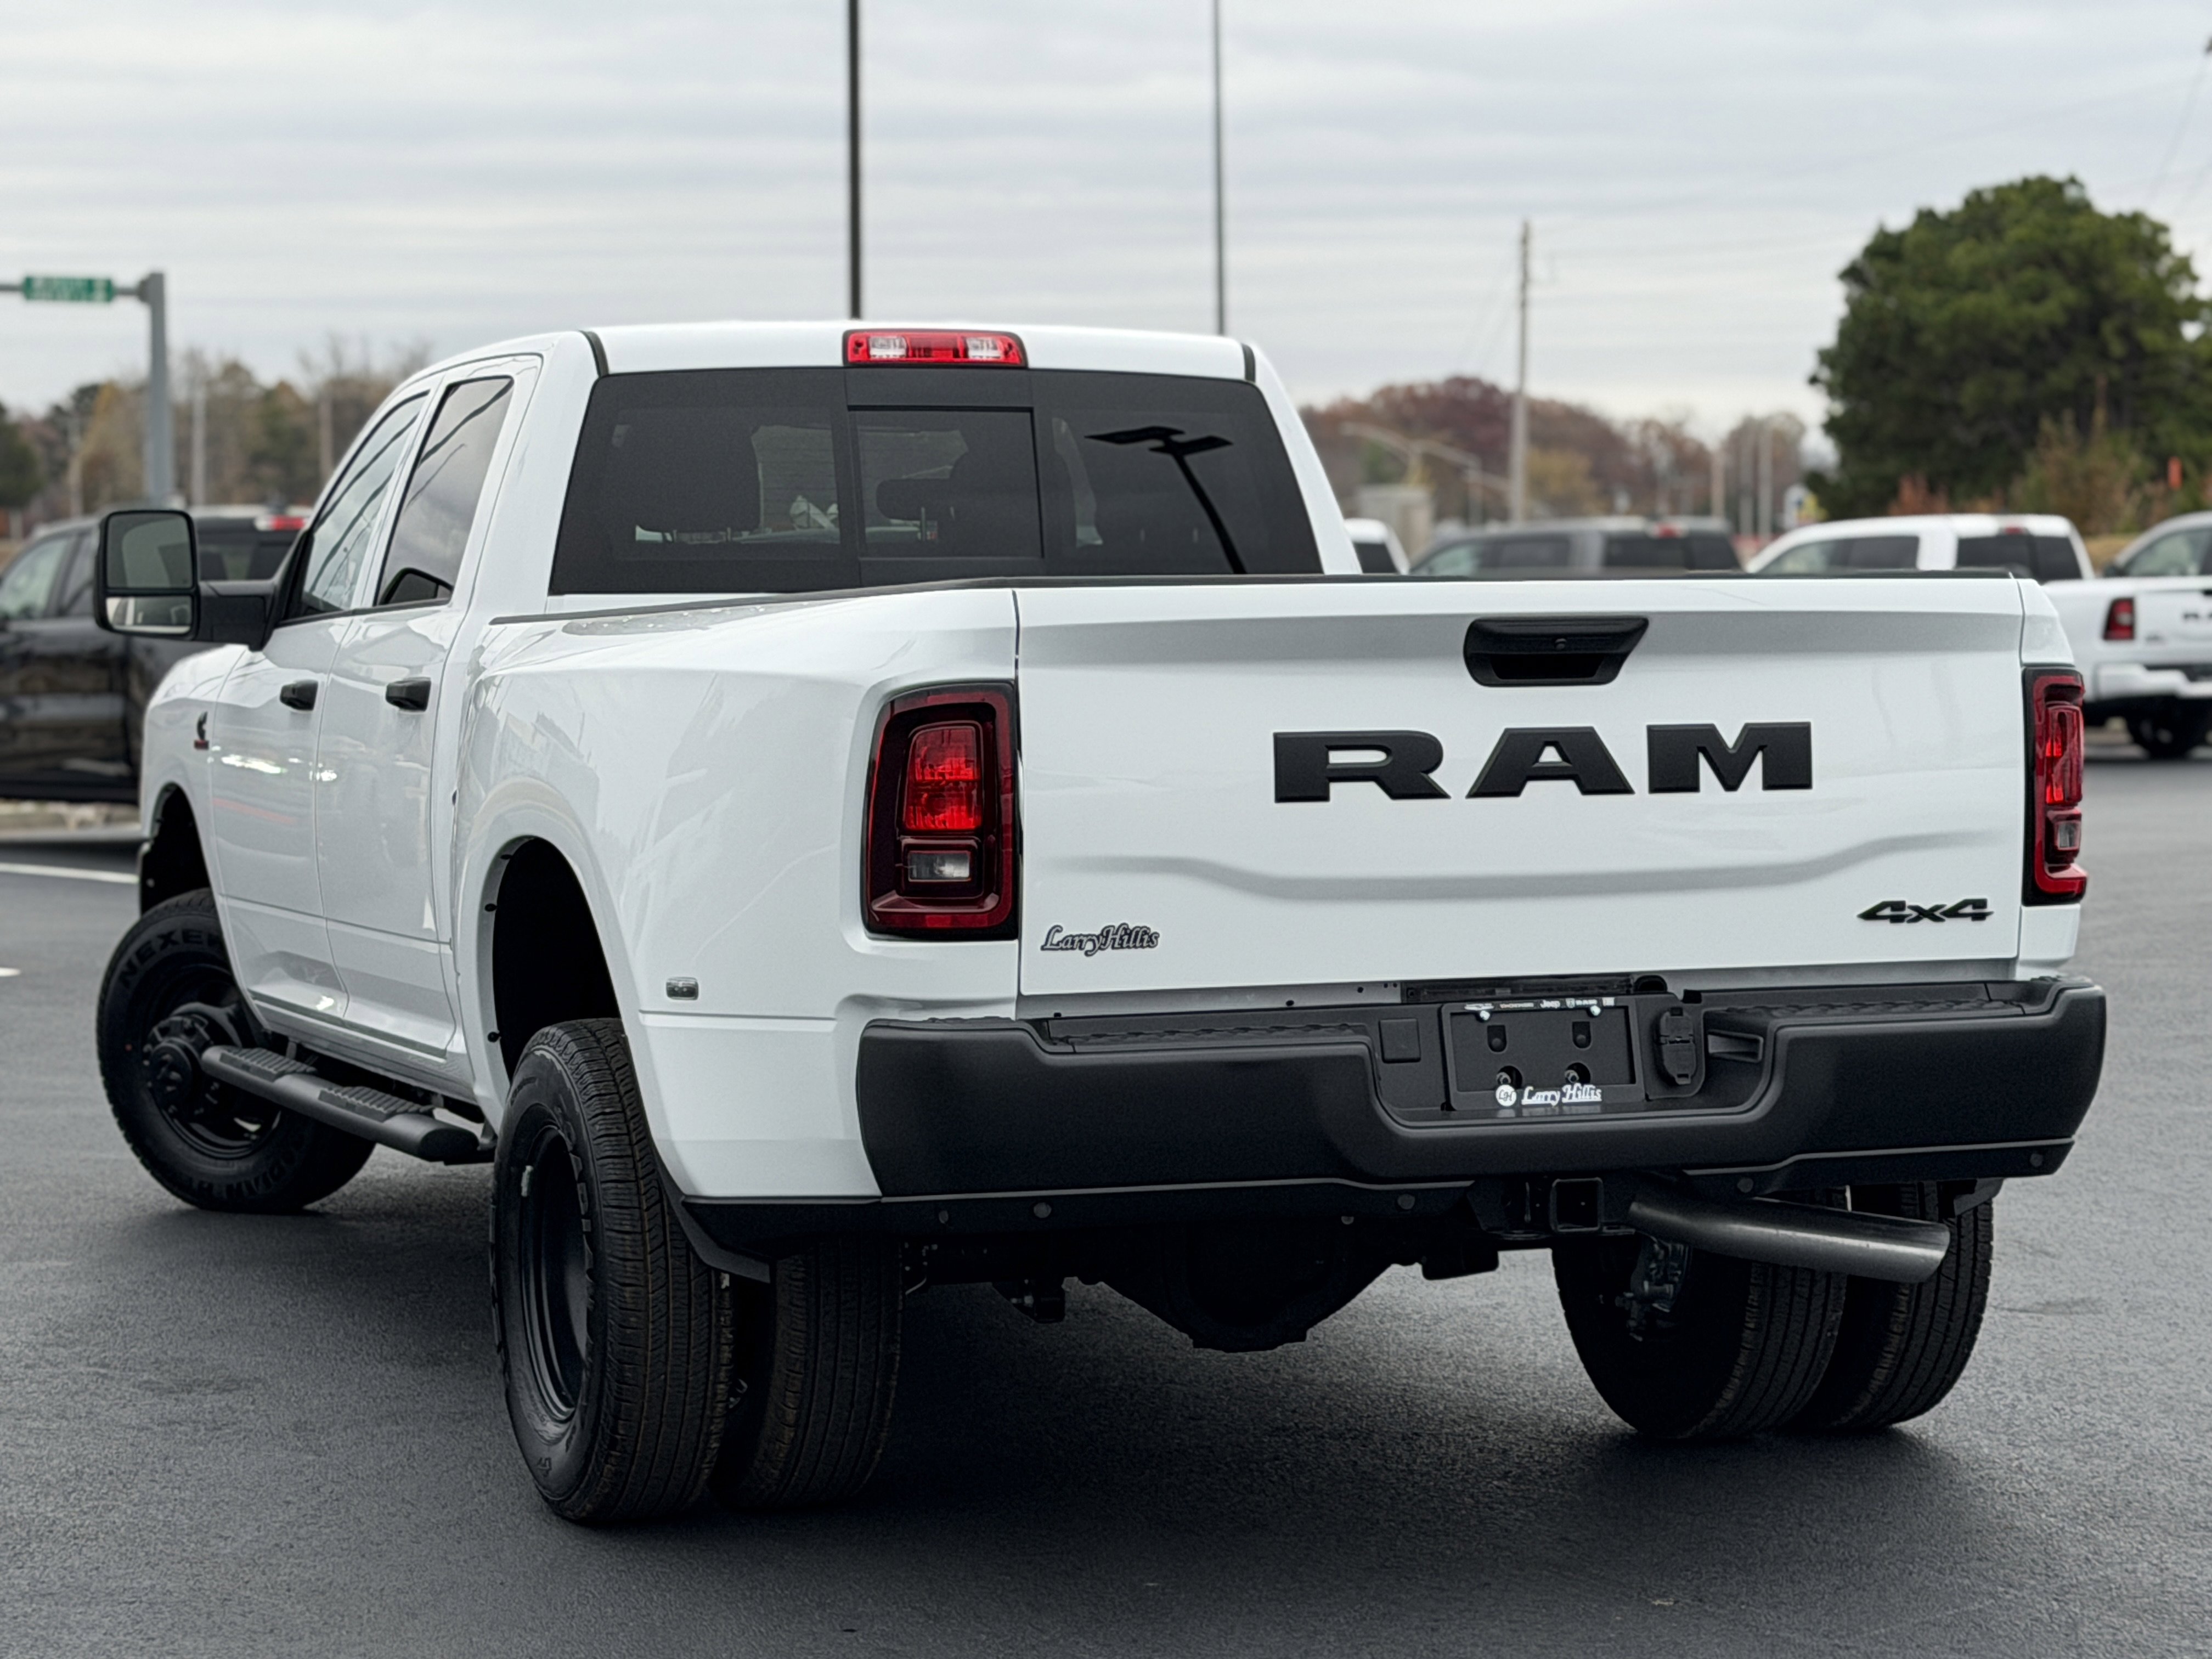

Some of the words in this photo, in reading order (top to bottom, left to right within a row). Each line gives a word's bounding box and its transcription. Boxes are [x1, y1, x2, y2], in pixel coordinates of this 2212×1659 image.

[1273, 721, 1813, 803] RAM
[1857, 898, 1994, 923] 4x4
[1521, 1086, 1560, 1107] Larry
[1562, 1083, 1602, 1103] Hillis
